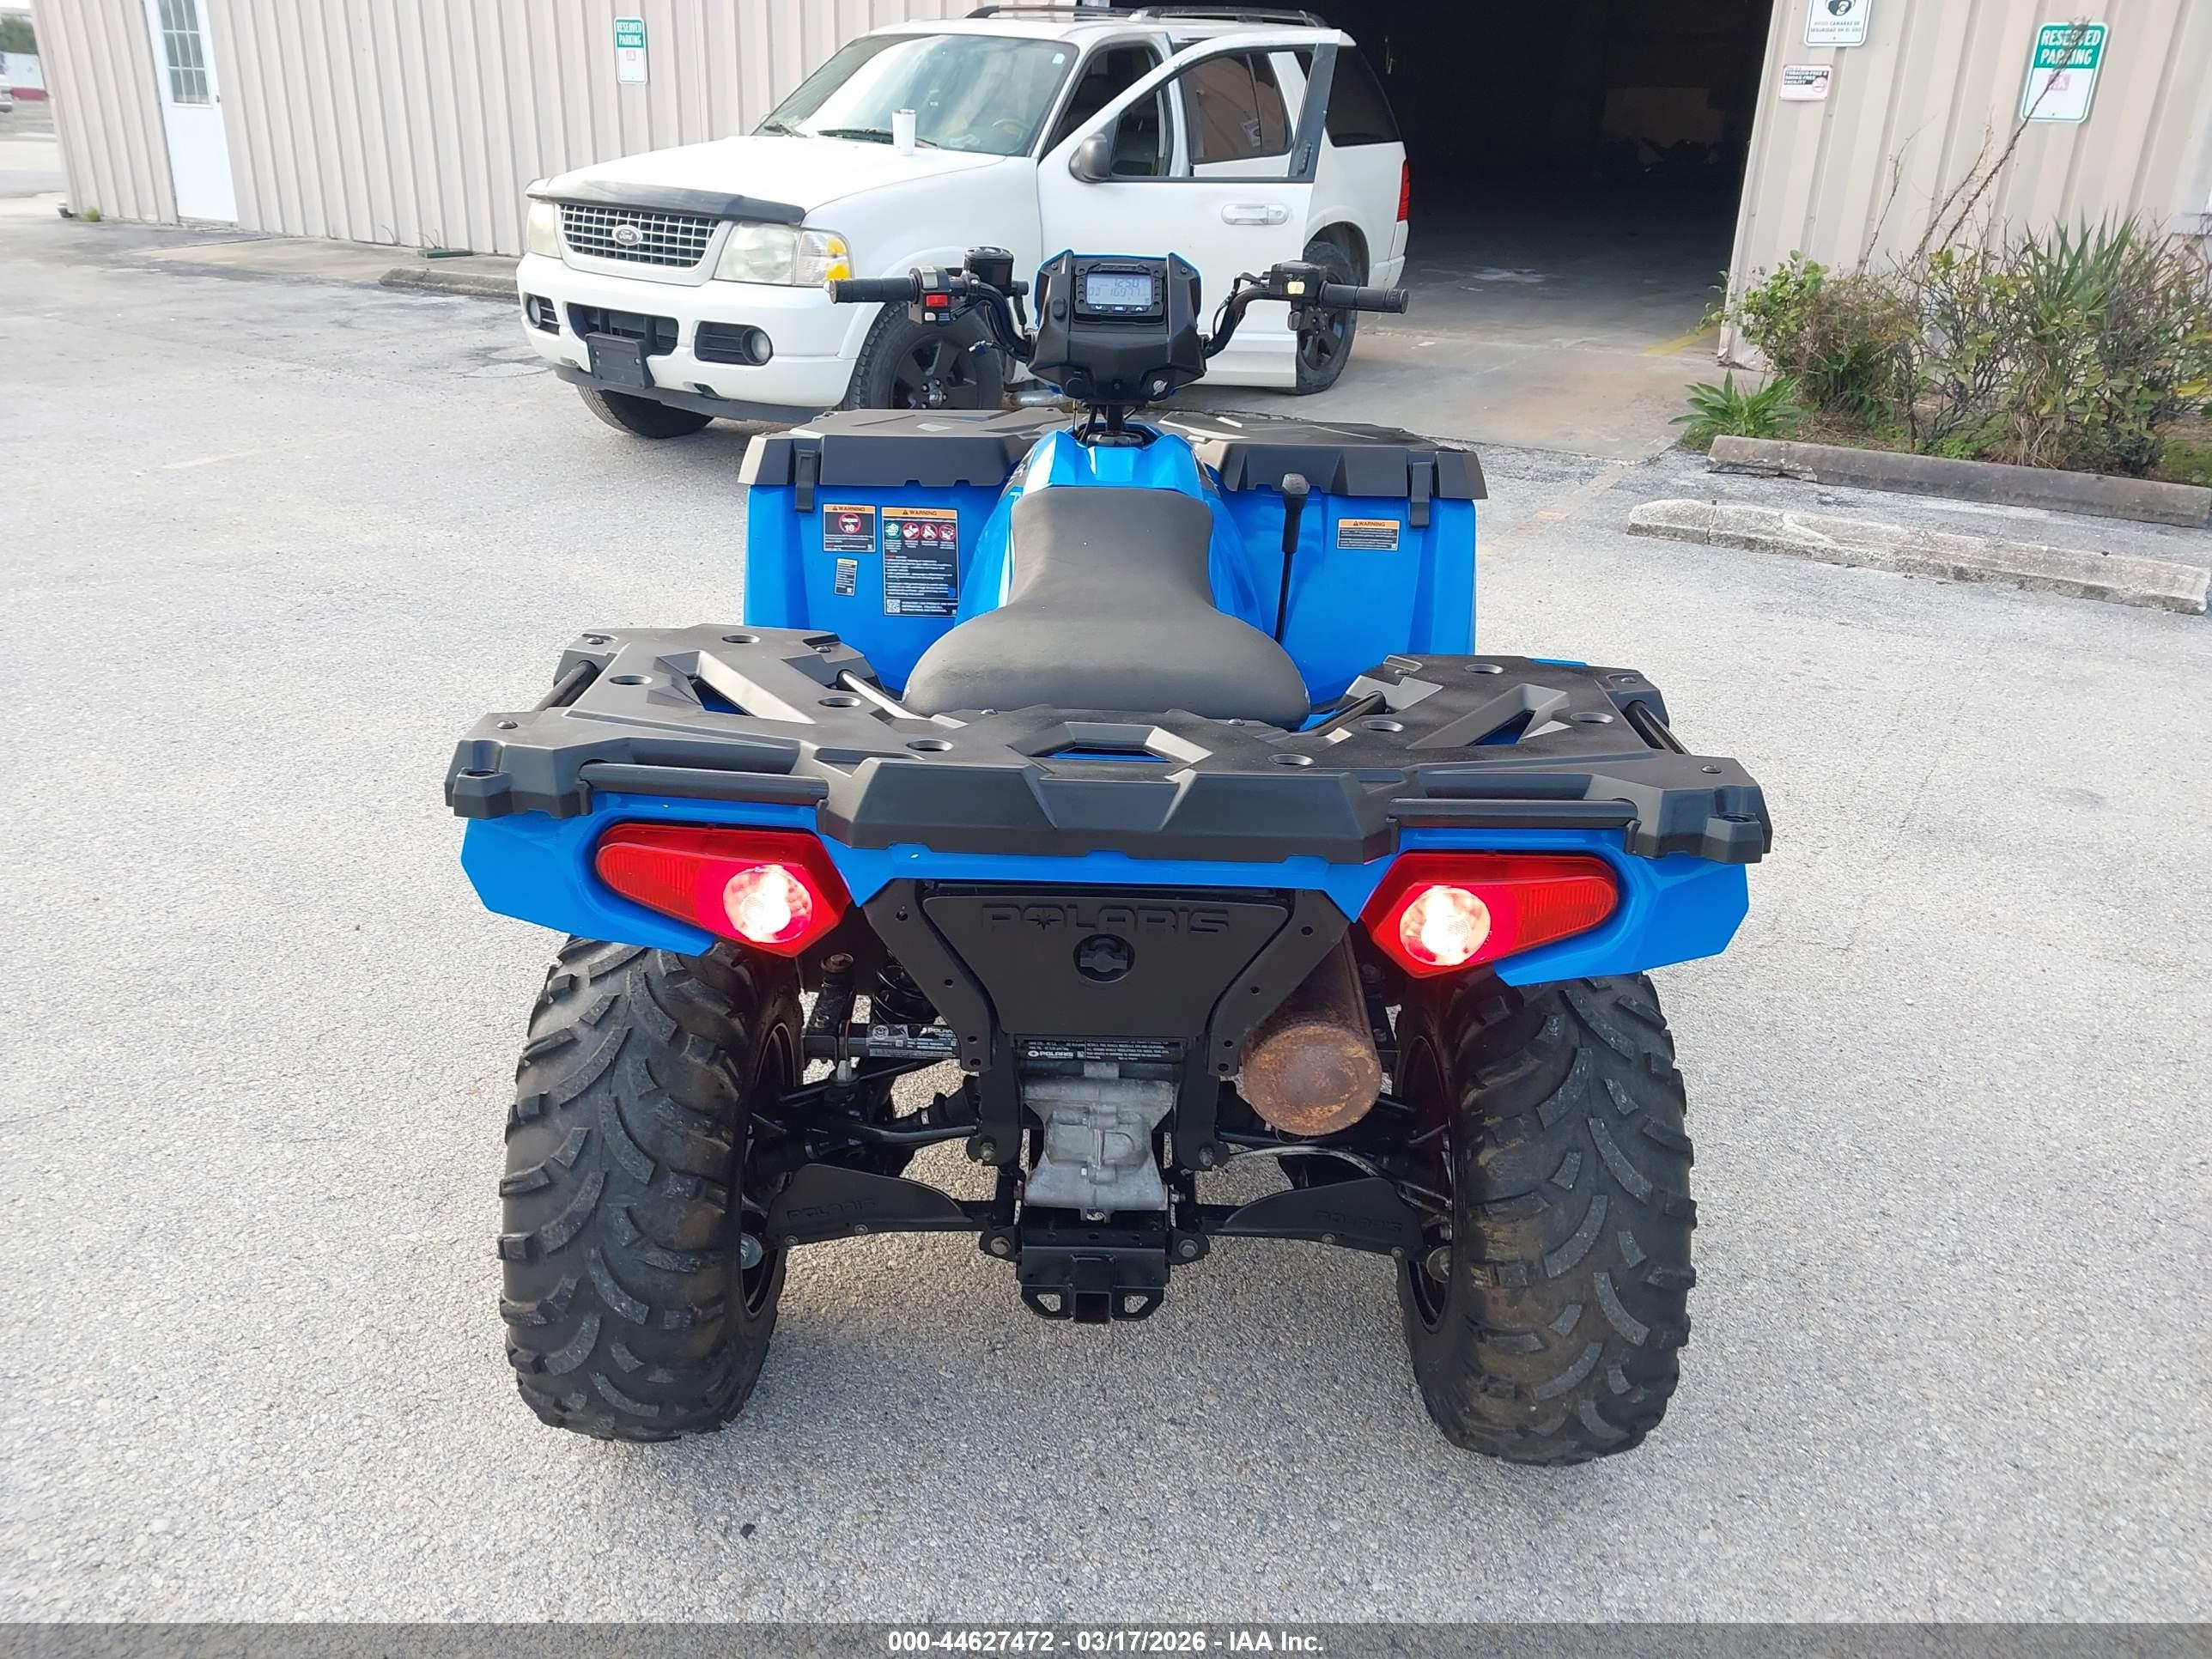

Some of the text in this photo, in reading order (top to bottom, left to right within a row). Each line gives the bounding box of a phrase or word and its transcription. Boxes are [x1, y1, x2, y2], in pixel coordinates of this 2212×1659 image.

[617, 21, 642, 33] RESERVED
[618, 34, 642, 46] PARKING
[981, 903, 1229, 933] POLARIS
